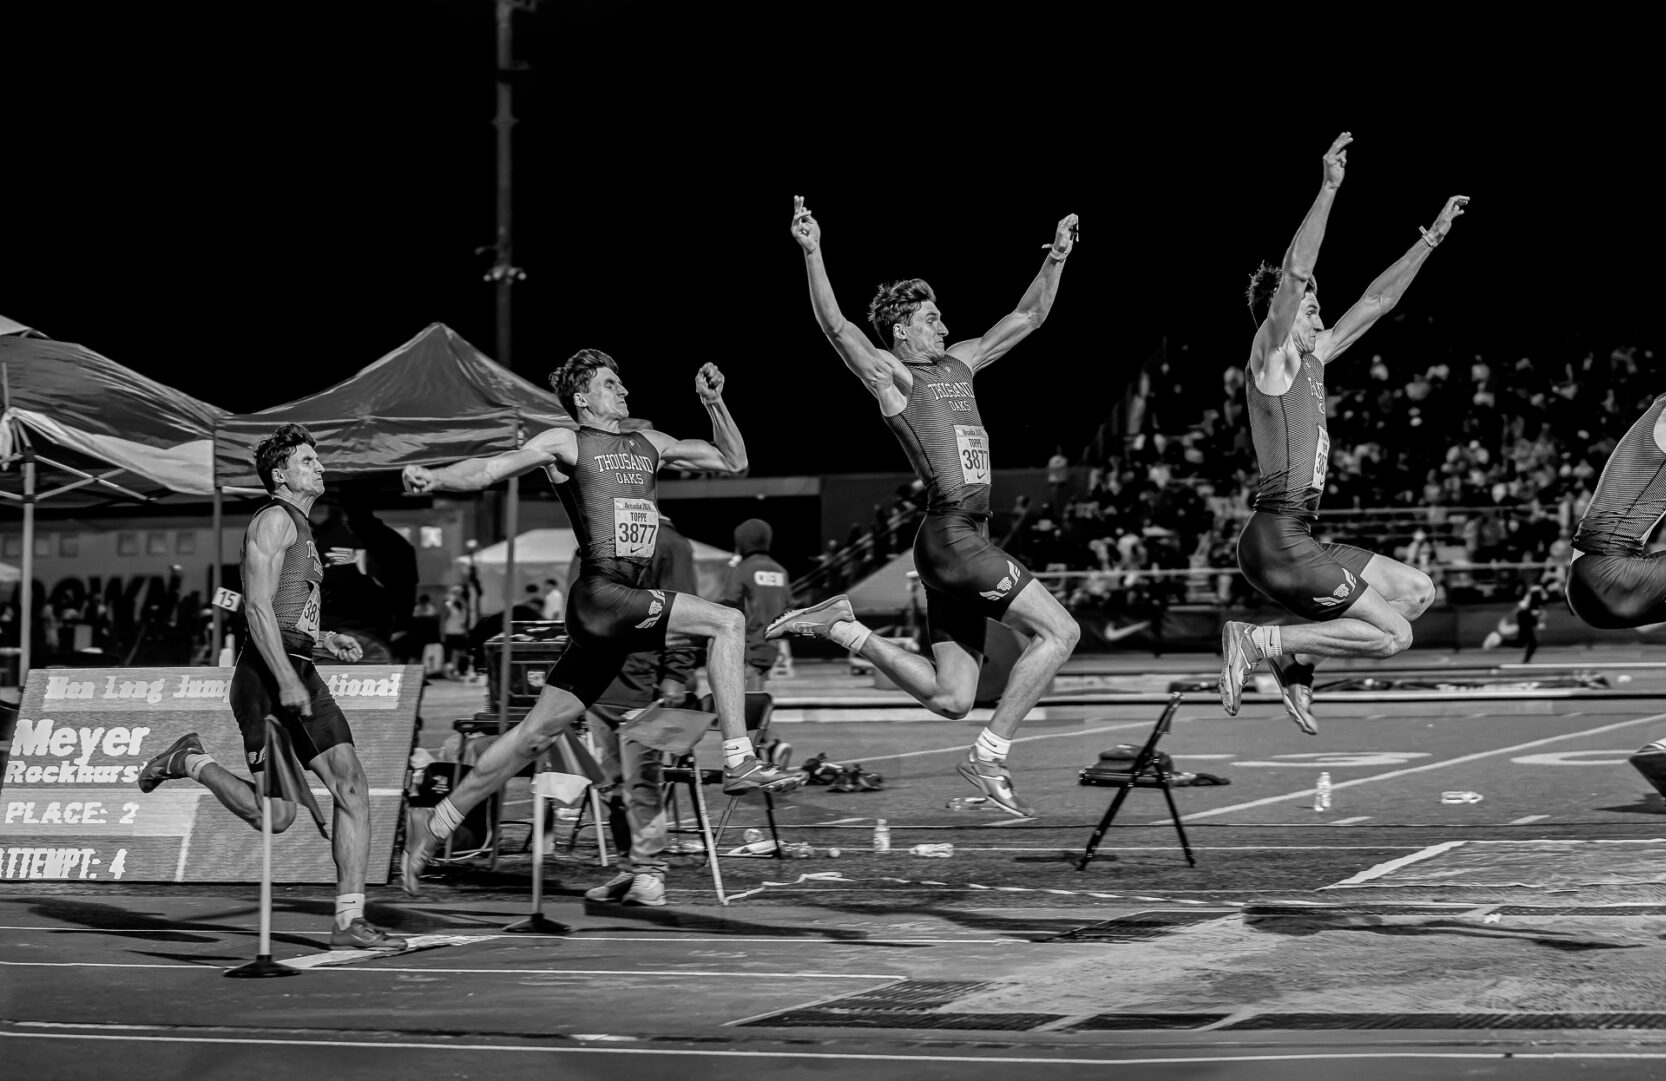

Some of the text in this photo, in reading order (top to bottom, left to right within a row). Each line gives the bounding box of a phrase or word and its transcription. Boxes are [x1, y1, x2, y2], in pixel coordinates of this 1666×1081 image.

[594, 453, 653, 474] THOUSAND
[962, 449, 989, 471] 3877
[616, 472, 644, 485] OAKS
[629, 512, 648, 522] TOPPE
[619, 522, 657, 545] 3877
[220, 590, 237, 607] 15
[9, 718, 150, 766] Meyer
[3, 760, 148, 783] Rockhurs
[119, 802, 140, 824] 2
[0, 847, 128, 879] TTEMPT: 4
